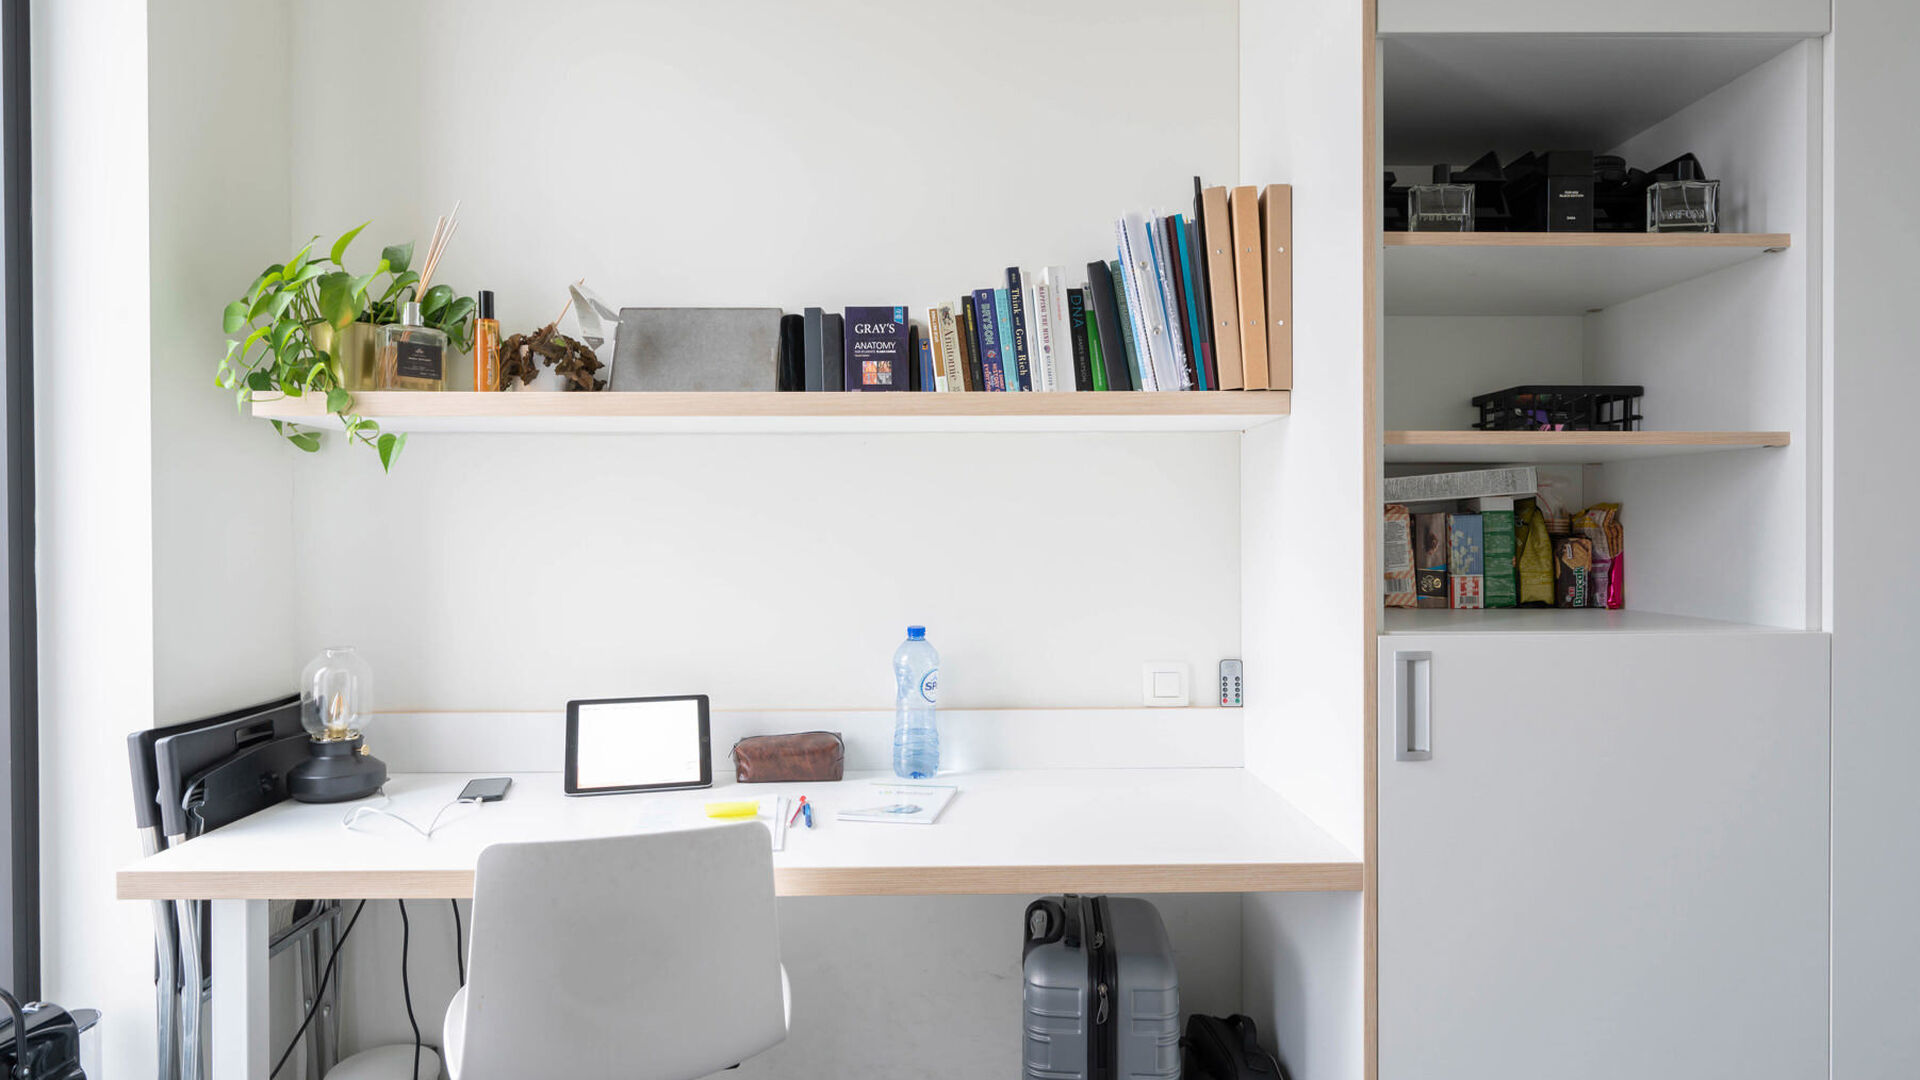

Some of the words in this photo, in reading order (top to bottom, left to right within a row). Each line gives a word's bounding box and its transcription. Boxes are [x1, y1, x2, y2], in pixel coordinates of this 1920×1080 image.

[1011, 288, 1022, 315] Think
[1039, 286, 1047, 313] MAPPING
[1070, 294, 1084, 328] DNA
[855, 324, 895, 334] GRAY'S
[981, 303, 995, 345] BRYSON
[1042, 328, 1050, 344] MIND
[855, 342, 896, 350] ANATOMY
[1015, 328, 1025, 351] Grow
[1018, 354, 1028, 376] Rich
[1078, 356, 1087, 382] WATSON
[1573, 566, 1585, 607] Burçak
[925, 681, 937, 691] SP
